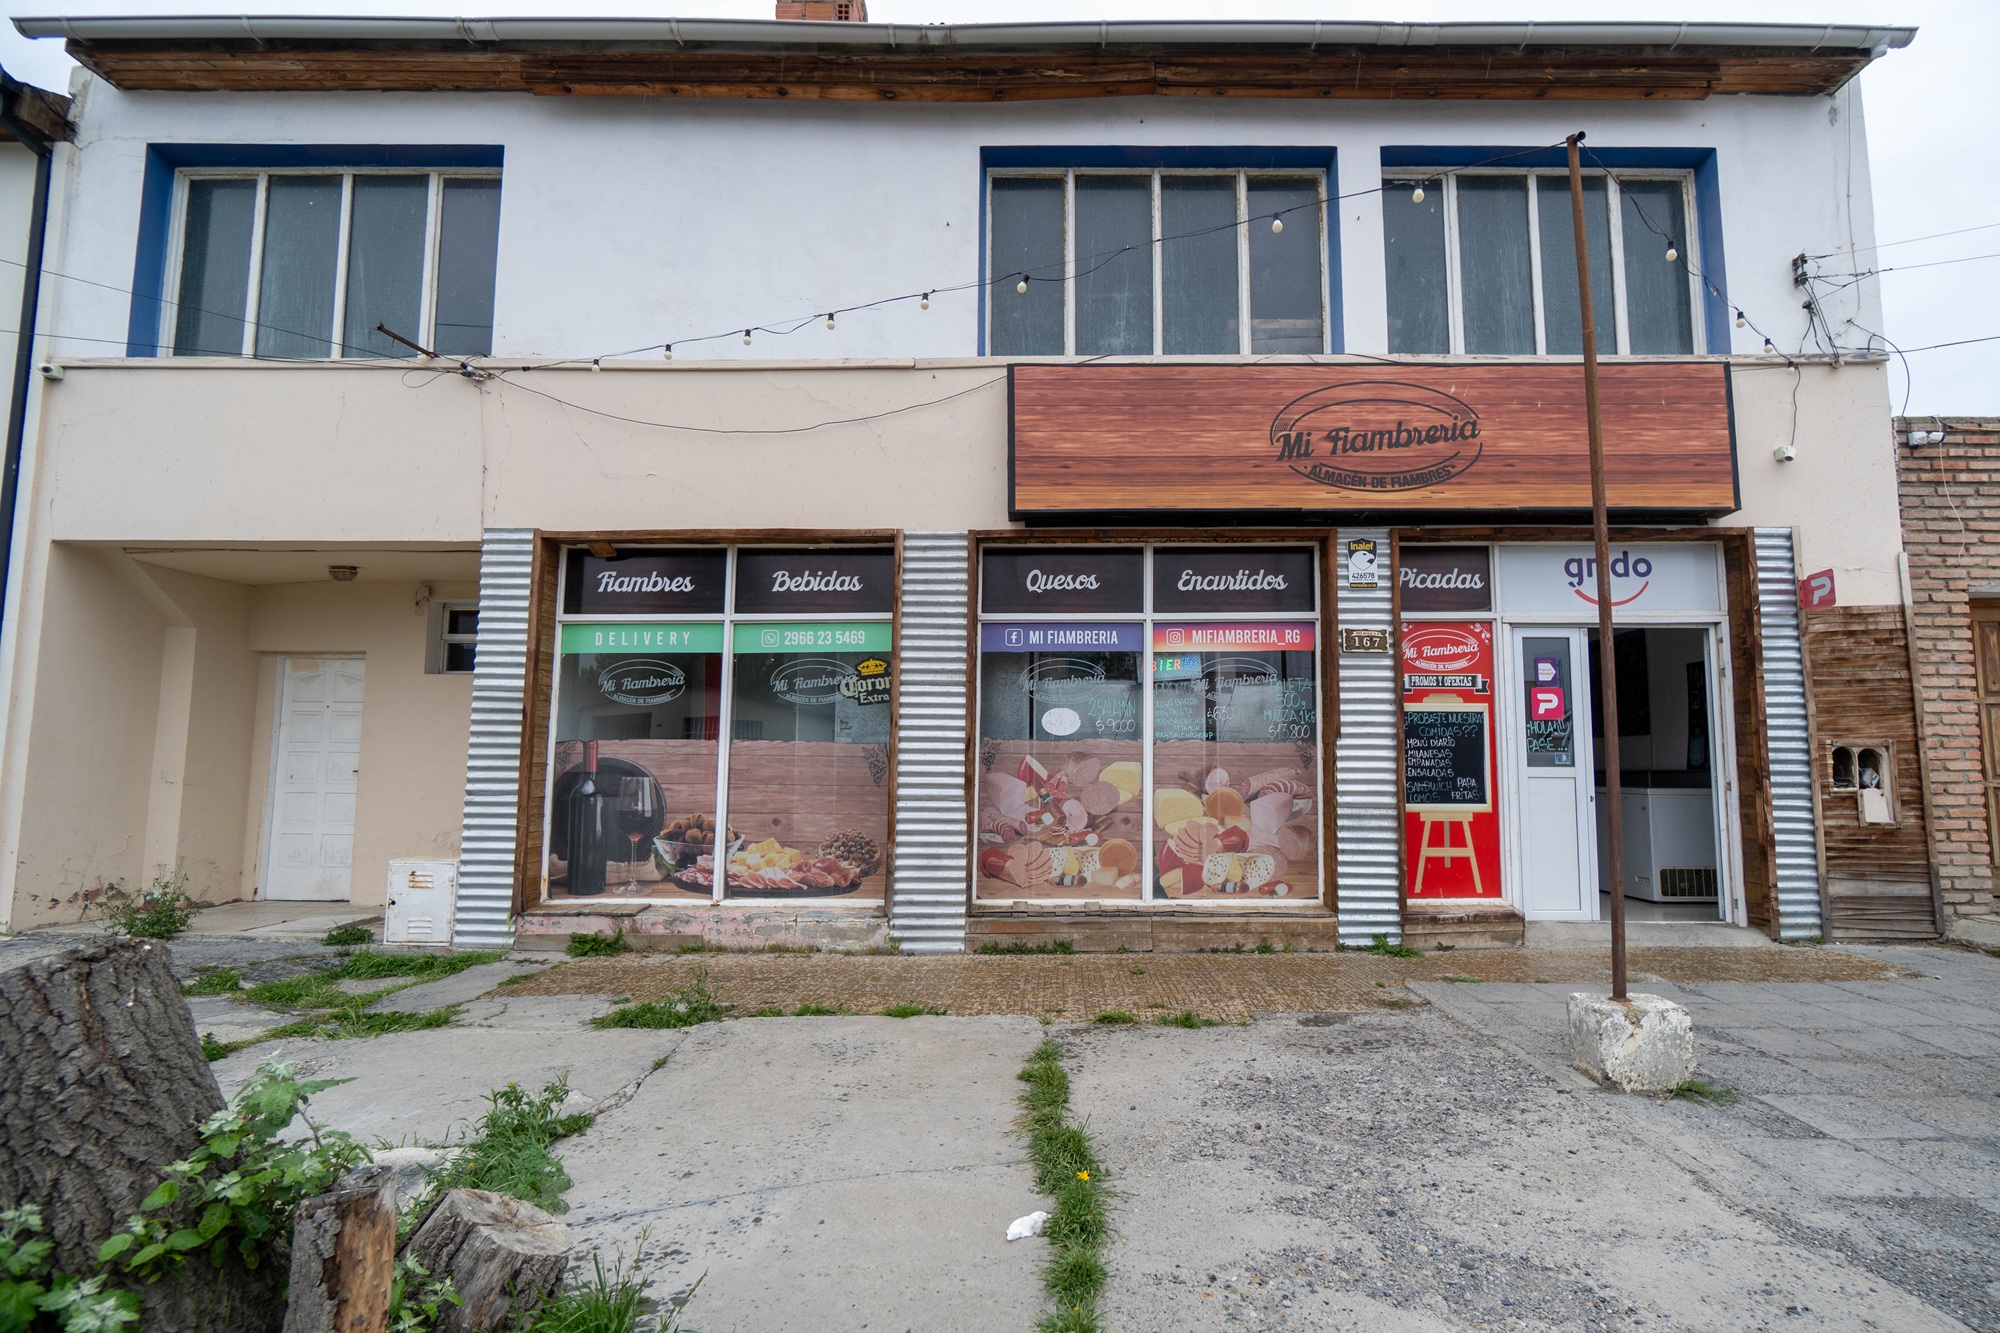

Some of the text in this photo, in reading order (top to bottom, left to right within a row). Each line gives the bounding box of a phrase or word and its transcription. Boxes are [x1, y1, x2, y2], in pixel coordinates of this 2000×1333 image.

[1276, 414, 1481, 461] Mi Fiambreria
[1308, 465, 1451, 489] ALMACÉN DE FIAMBRES
[1350, 541, 1374, 551] Inalef
[1564, 551, 1652, 587] grdo
[597, 571, 695, 593] Fiambres
[771, 570, 863, 592] Bebidas
[1026, 569, 1100, 593] Quesos
[1178, 569, 1288, 592] Encurtidos
[1399, 567, 1484, 590] Picadas
[595, 631, 691, 646] DELIVERY
[784, 630, 865, 646] 2966 23 5469
[1029, 630, 1118, 644] MI FIAMBRERIA
[1192, 629, 1300, 645] MIFIAMBRERIA_RG
[1354, 636, 1380, 648] 167
[1403, 642, 1479, 659] Mi Fiambreria
[600, 674, 685, 692] Mi Fiambreria
[773, 679, 788, 692] Mi
[1022, 679, 1037, 692] Mi
[1411, 675, 1472, 686] PROMOS Y OFERTAS
[860, 693, 889, 703] Extra
[1537, 694, 1559, 714] P
